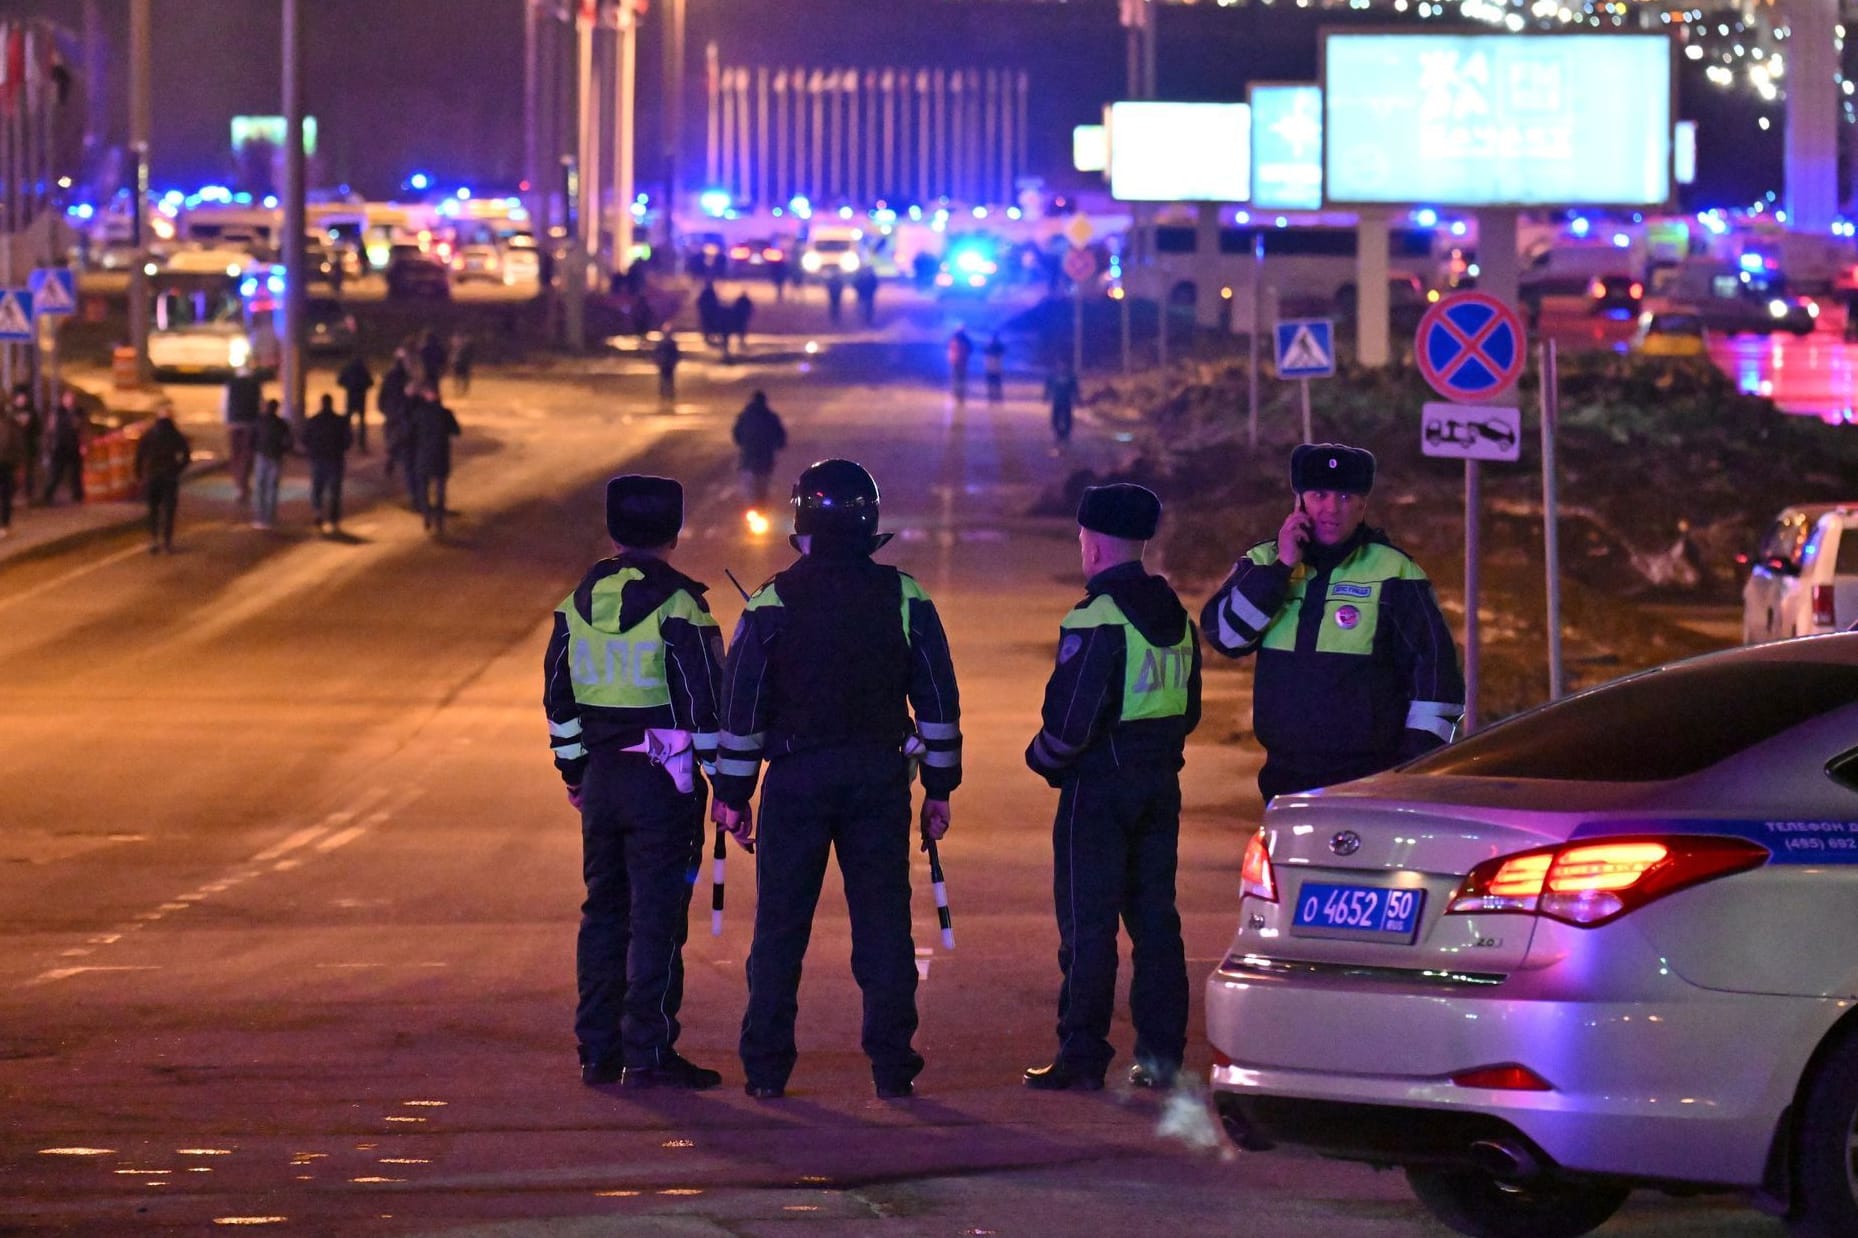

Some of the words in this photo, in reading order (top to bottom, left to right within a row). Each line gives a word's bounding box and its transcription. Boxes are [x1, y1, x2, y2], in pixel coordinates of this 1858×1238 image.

[572, 639, 659, 687] ДПС
[1765, 822, 1844, 832] ТЕЛЕФОН
[1785, 838, 1825, 851] (495)
[1323, 889, 1379, 927] 4652
[1386, 891, 1414, 919] 50
